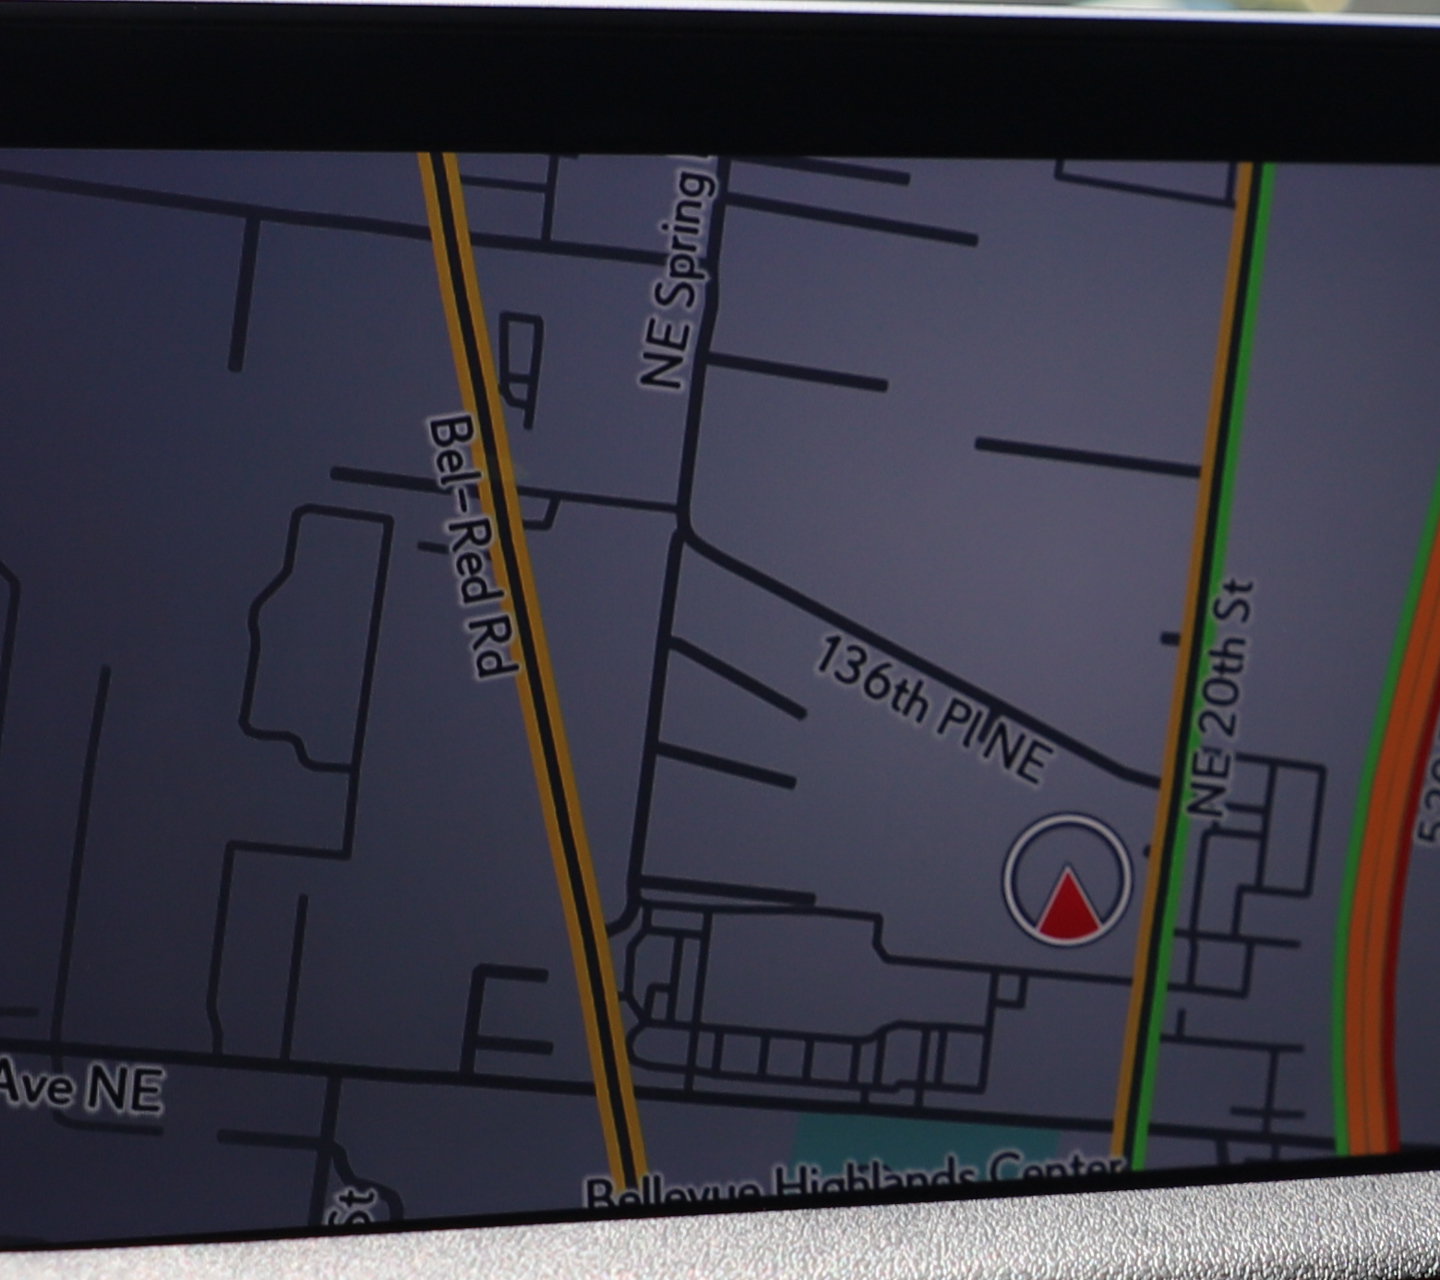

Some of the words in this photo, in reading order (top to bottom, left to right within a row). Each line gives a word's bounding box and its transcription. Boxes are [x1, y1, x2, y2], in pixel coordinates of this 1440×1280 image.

[653, 170, 716, 308] Spring
[639, 317, 691, 390] NE
[430, 415, 505, 604] Bel-Red
[468, 615, 520, 679] Rd
[1212, 577, 1254, 623] St
[817, 634, 930, 724] 136th
[937, 696, 983, 749] Pl
[982, 721, 1055, 786] NE
[1197, 636, 1247, 738] 20th
[1186, 751, 1232, 818] NE
[87, 1064, 164, 1113] NE
